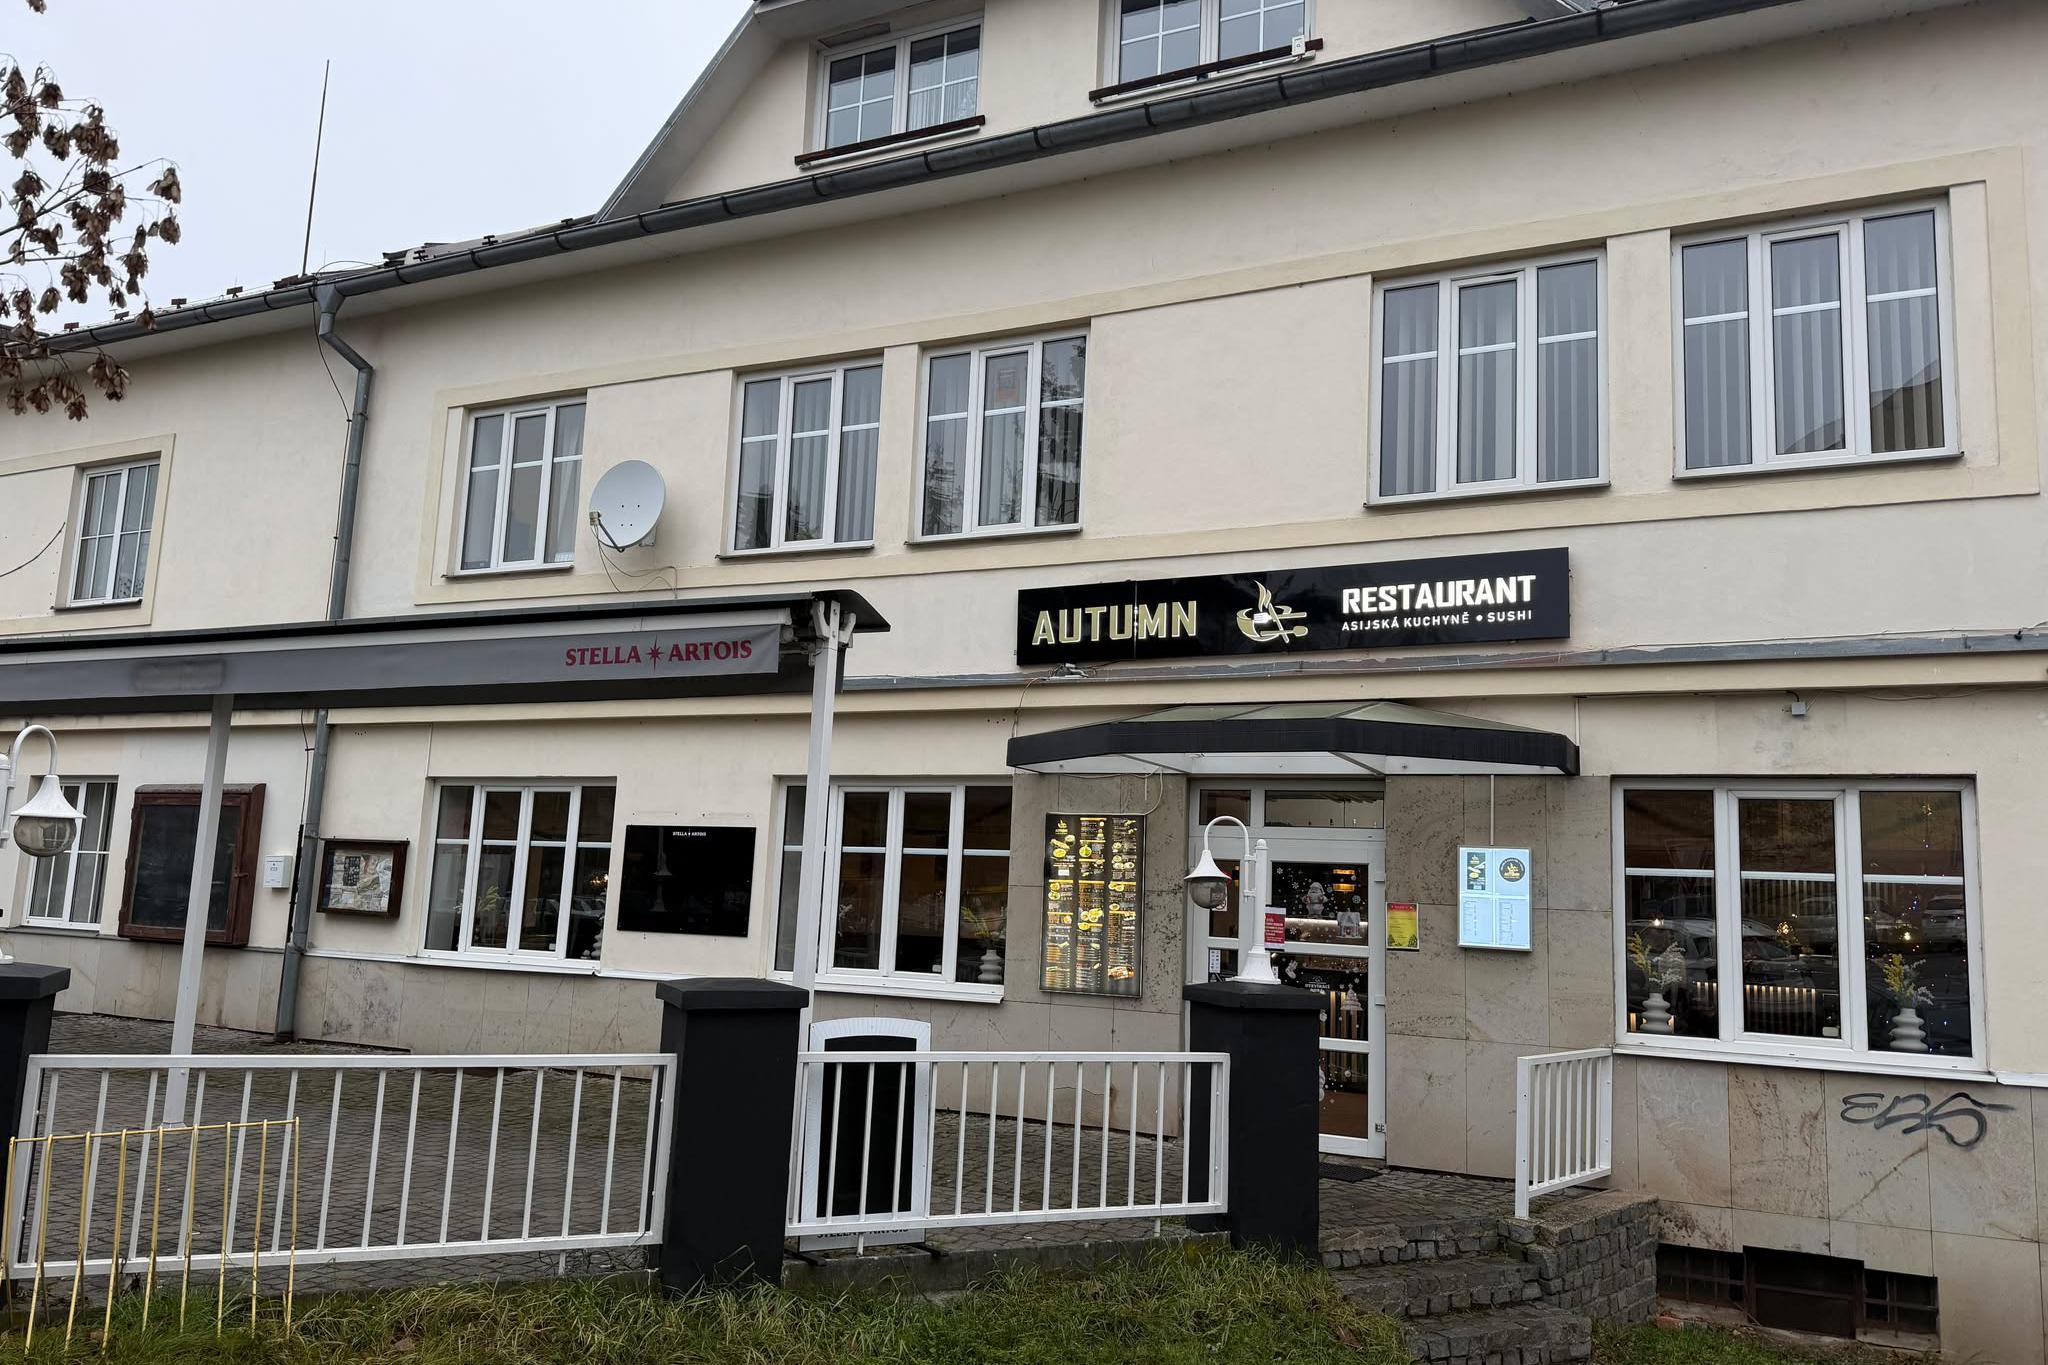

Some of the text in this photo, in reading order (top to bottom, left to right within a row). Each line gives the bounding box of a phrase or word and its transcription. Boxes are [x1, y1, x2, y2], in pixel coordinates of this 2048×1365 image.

[1342, 574, 1537, 614] RESTAURANT
[1031, 600, 1197, 646] AUTUMN
[1341, 609, 1532, 631] ASIJSKÁ KUCHYNĚ SUSHI
[565, 639, 753, 666] STELLA ARTOIS
